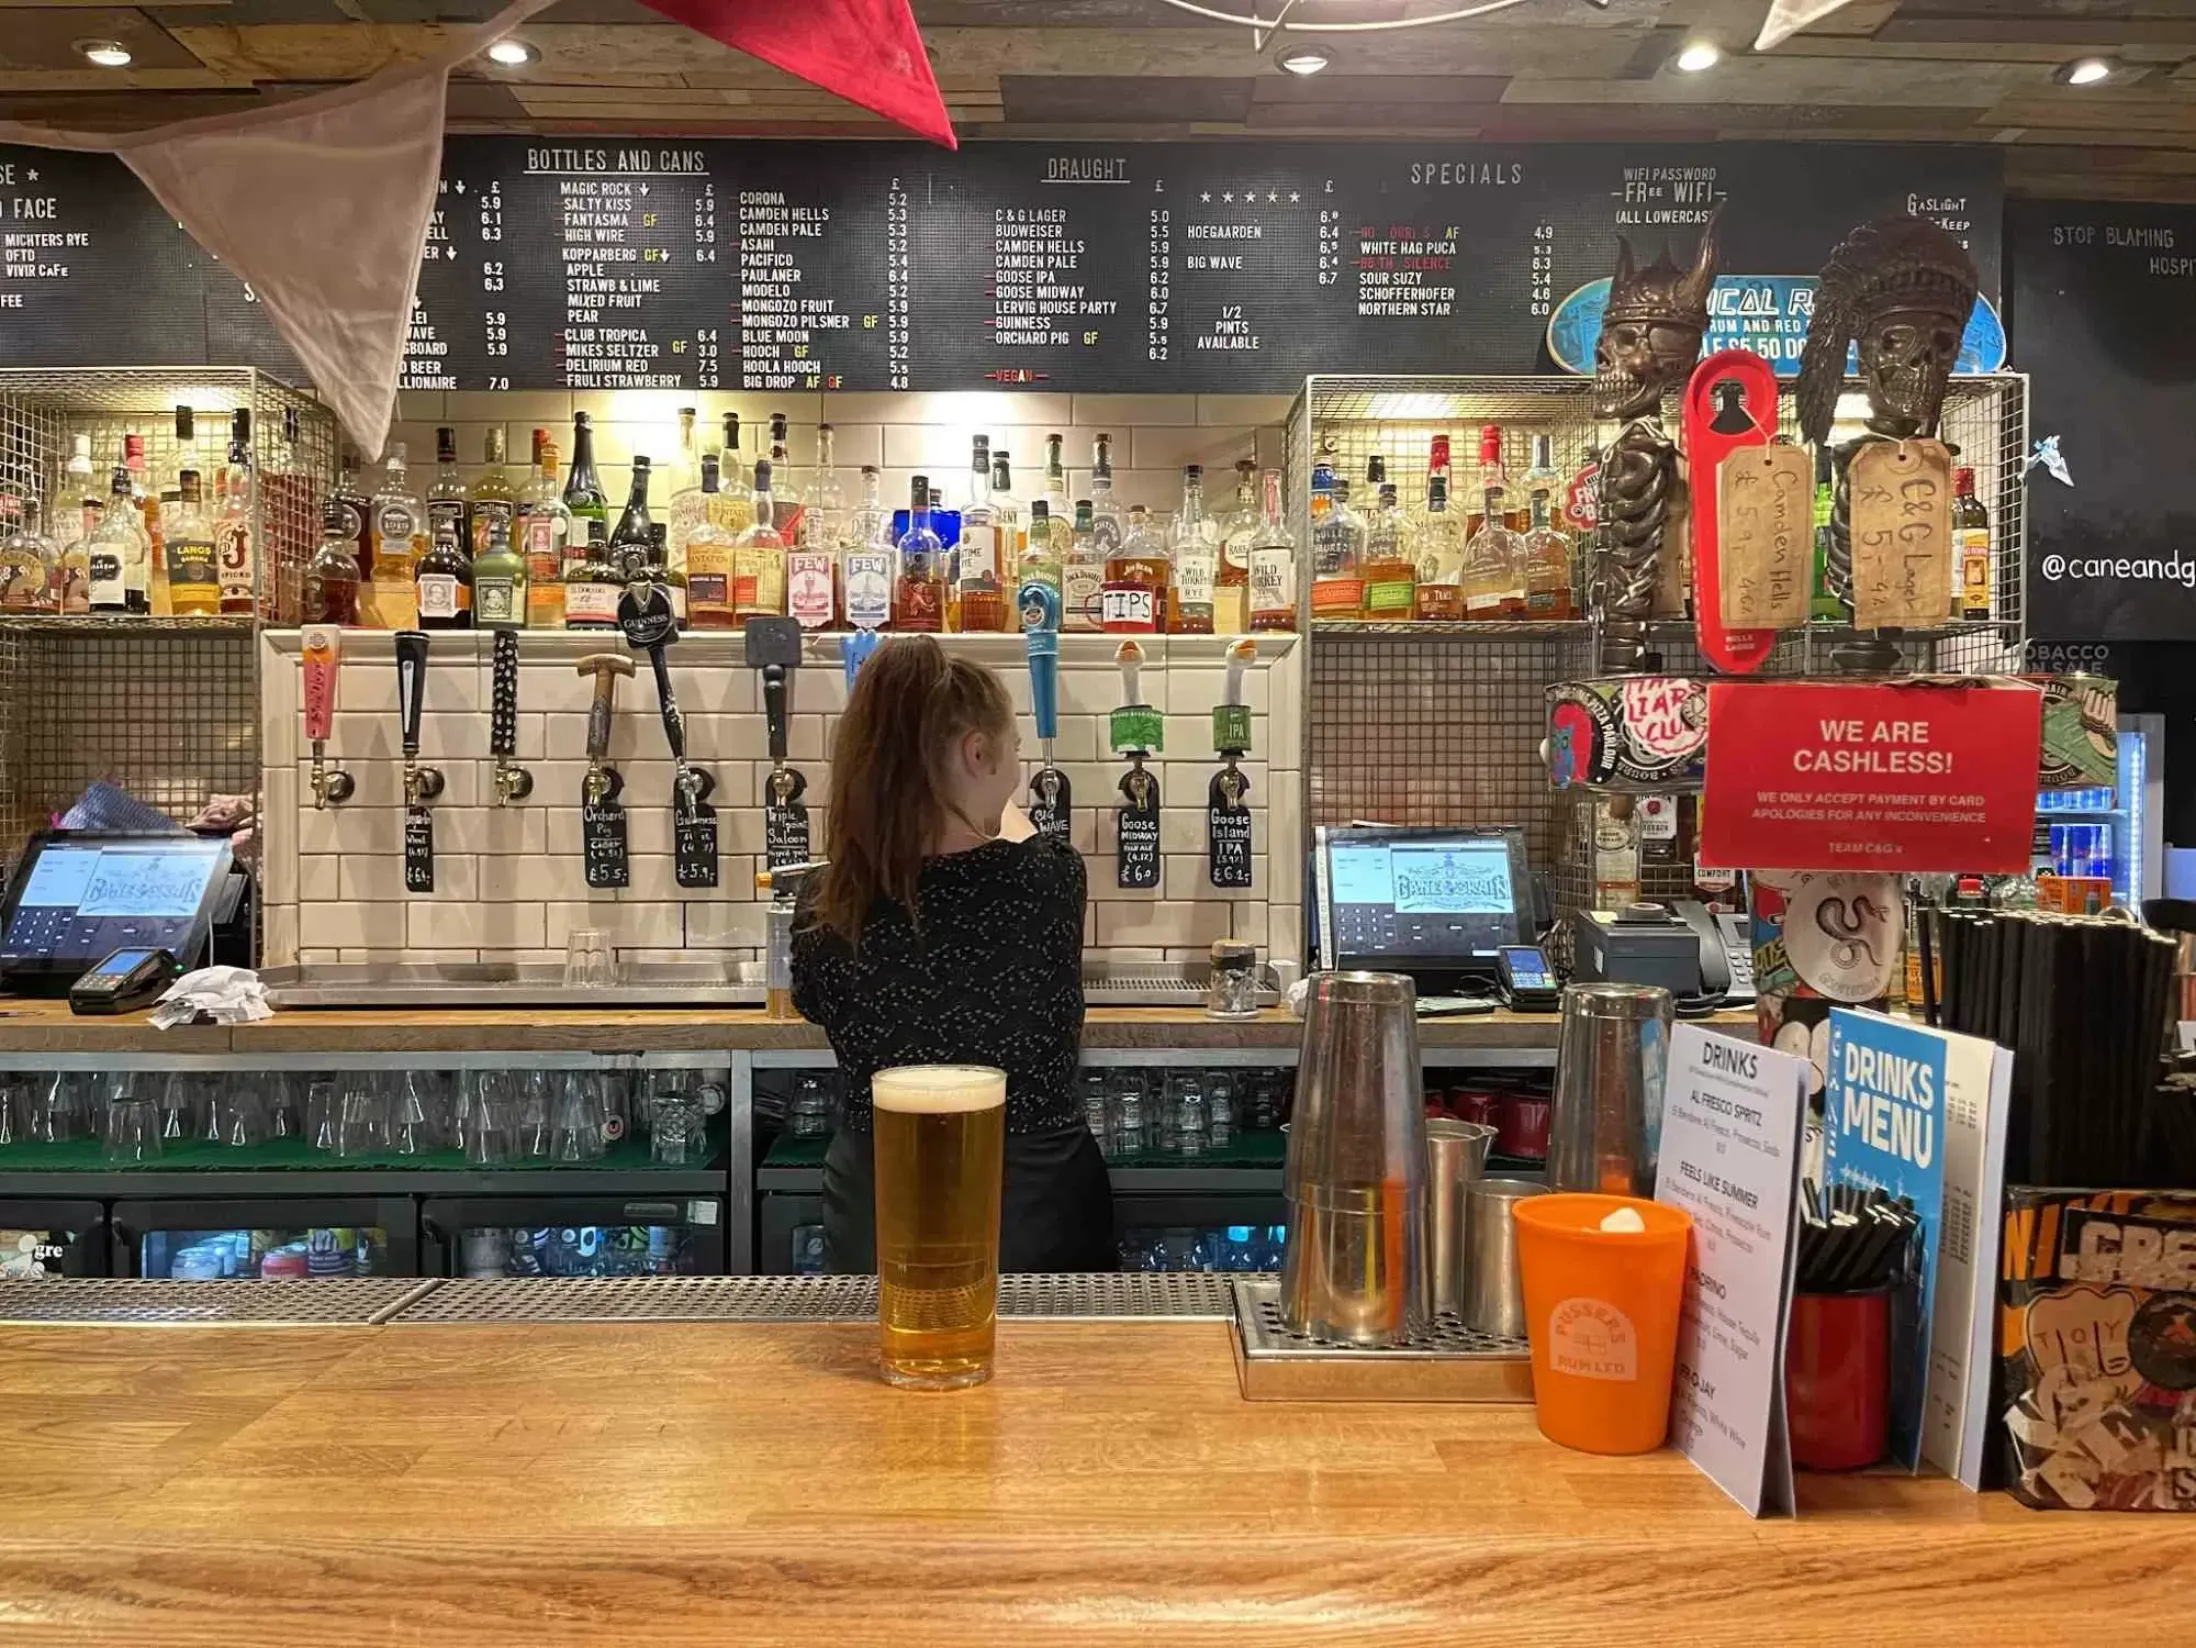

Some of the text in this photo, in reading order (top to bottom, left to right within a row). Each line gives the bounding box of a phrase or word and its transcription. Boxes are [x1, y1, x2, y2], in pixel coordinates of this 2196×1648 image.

[528, 149, 704, 171] BOTTLES AND CANS
[1048, 158, 1126, 179] DRAUGHT
[1411, 164, 1522, 184] SPECIALS
[1625, 168, 1716, 180] WIFI PASSWORD
[560, 182, 632, 195] MAGIC ROCK
[564, 198, 632, 211] SALTY KISS
[740, 192, 784, 205] CORONA
[14, 198, 57, 219] FACE
[740, 208, 829, 221] CAMDEN HELLS
[564, 213, 629, 226] FANTASMA
[1030, 210, 1066, 222] LAGER
[565, 229, 625, 242] HIGH WIRE
[740, 223, 822, 236] CAMDEN PALE
[996, 225, 1062, 237] BUDWEISER
[1188, 226, 1261, 238] HOEGAARDEN
[5, 233, 88, 247] MICHTERS RYE
[2054, 226, 2174, 248] STOP BLAMING
[741, 239, 774, 251] ASAHI
[996, 240, 1085, 253] CAMDEN HELLS
[1361, 242, 1456, 255] WHITE HAG PUCA
[6, 250, 35, 262] OFTD
[562, 249, 636, 261] KOPPARBERG
[741, 254, 793, 266] PACIFICO
[996, 256, 1076, 268] CAMDEN PALE
[1188, 256, 1243, 269] BIG WAVE
[6, 264, 36, 277] VIVIR
[567, 264, 604, 277] APPLE
[741, 269, 801, 282] PAULANER
[996, 271, 1055, 284] GOOSE IPA
[1359, 273, 1422, 285] SOUR SUZY
[567, 279, 660, 293] STRAWB LIME
[742, 284, 790, 297] MODELO
[996, 286, 1084, 299] GOOSE MIDWAY
[1359, 288, 1455, 300] SCHOFFERHOFER
[568, 295, 642, 308] MIXED FRUIT
[742, 300, 834, 312] MONGOZO FRUIT
[996, 302, 1116, 315] LERVIG HOUSE PARTY
[1222, 306, 1242, 319] 1/2
[1358, 303, 1450, 315] NORTHERN STAR
[568, 310, 598, 323] PEAR
[742, 315, 849, 328] MONGOZO PILSNER
[996, 317, 1050, 329] GUINNESS
[1216, 321, 1248, 334] PINTS
[1743, 320, 1801, 332] AND RED
[564, 329, 647, 342] CLUB TROPICA
[742, 330, 809, 343] BLUE MOON
[996, 332, 1069, 344] ORCHARD PIG
[1198, 336, 1260, 349] AVAILABLE
[566, 344, 659, 357] MIKES SELTZER
[743, 345, 779, 358] HOOCH
[411, 361, 441, 374] BEER
[566, 359, 648, 372] DELIRIUM RED
[743, 360, 820, 373] HOOLA HOOCH
[567, 374, 681, 388] FRULI STRAWBERRY
[744, 375, 795, 389] BIG DROP
[1769, 470, 1798, 610] Camden Hells
[795, 558, 825, 572] FEW
[852, 558, 885, 572] FEW
[1105, 593, 1150, 617] TIPS
[624, 614, 668, 627] GUINNESS
[2026, 645, 2109, 660] OBACCO
[1230, 724, 1244, 738] IPA
[1820, 720, 1929, 743] WE ARE
[1793, 751, 1953, 773] CASHLESS!
[1757, 792, 1985, 806] WE ONLY ACCEPT PAYMENT BY CARD
[1122, 813, 1156, 830] Goose
[1211, 808, 1250, 825] Goose
[1752, 809, 1986, 823] APOLOGIES FOR ANY INCONVENIENCE
[1121, 832, 1158, 840] MIDWAY
[1219, 844, 1242, 854] IPA
[1828, 842, 1863, 853] TEAM
[1703, 1042, 1758, 1079] DRINKS
[1845, 1042, 1933, 1111] DRINKS
[1702, 1092, 1733, 1116] FRESCO
[1734, 1103, 1762, 1128] SPRITZ
[1843, 1089, 1933, 1171] MENU
[1680, 1161, 1758, 1210] FEELS LIKE SUMMER
[1558, 1355, 1591, 1372] RUM
